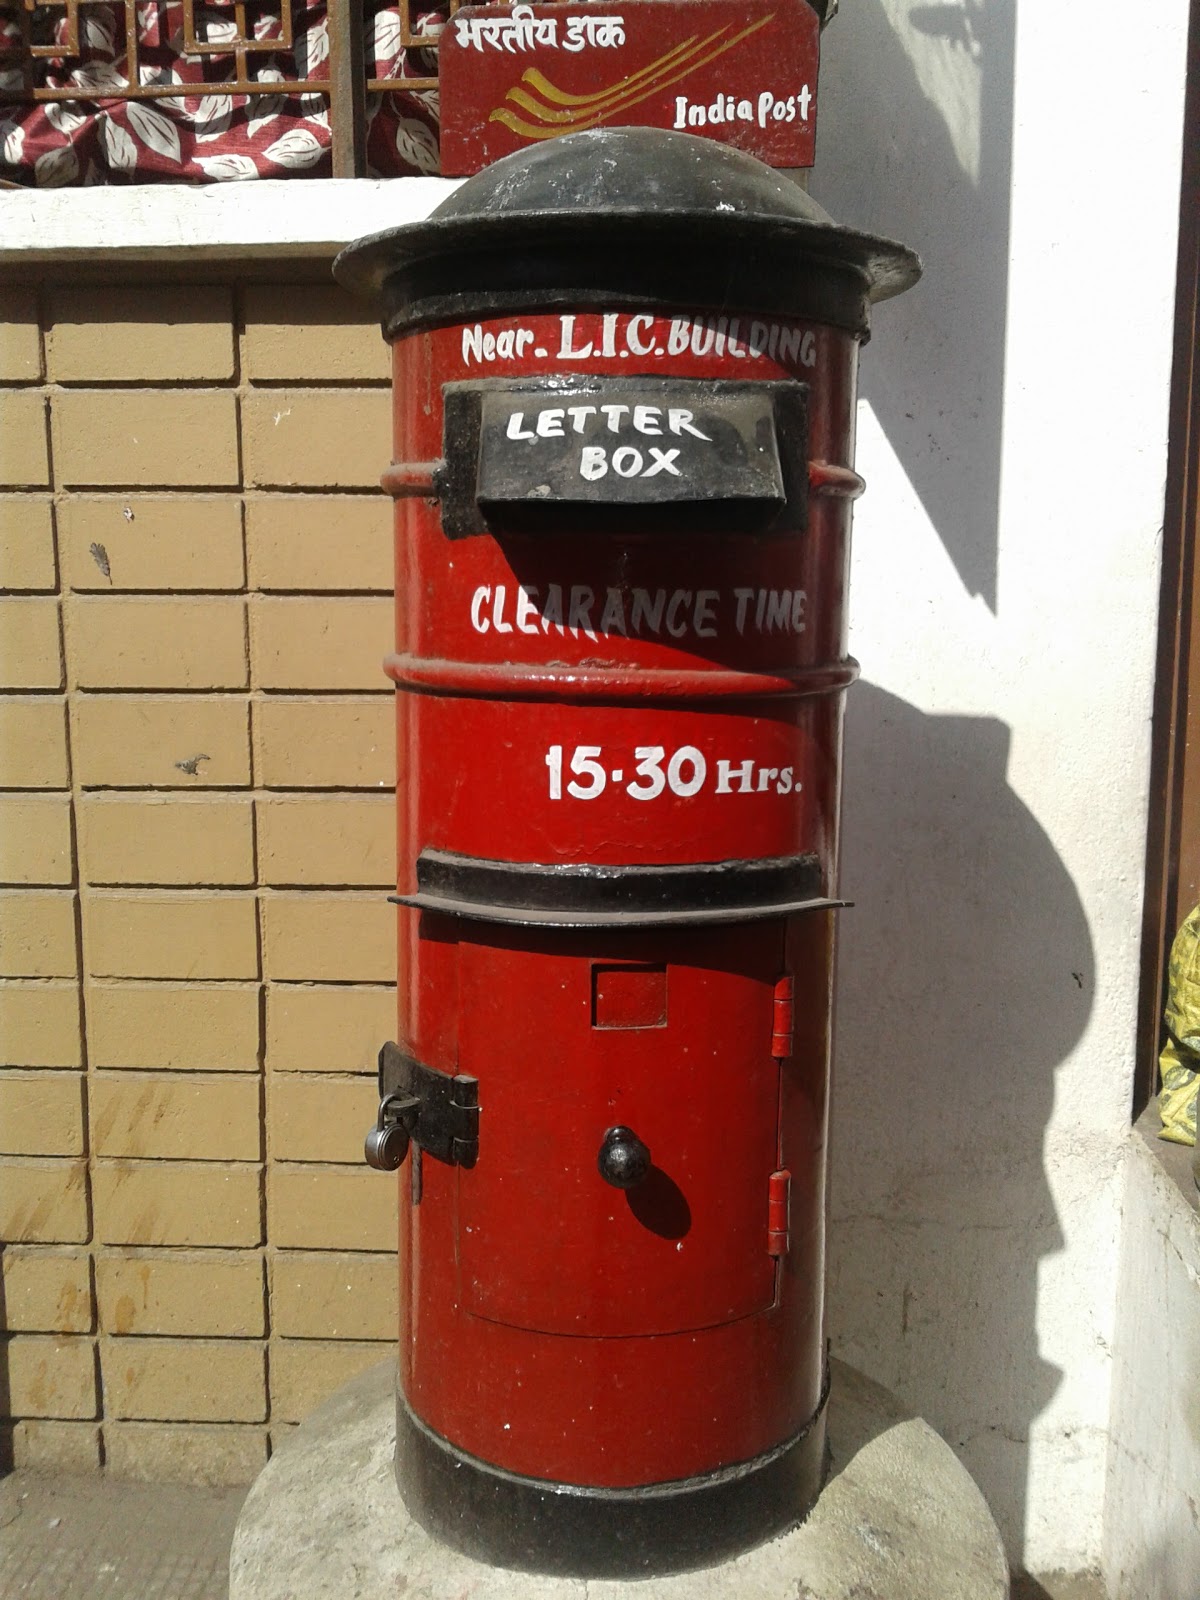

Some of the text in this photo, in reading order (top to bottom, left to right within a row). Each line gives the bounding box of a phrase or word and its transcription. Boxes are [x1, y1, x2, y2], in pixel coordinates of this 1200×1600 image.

[562, 15, 626, 52] डाक
[673, 84, 812, 129] India Post
[667, 314, 817, 368] BUILDING
[506, 405, 713, 442] LETTER
[580, 446, 684, 481] BOX
[471, 583, 807, 643] CLEARANCE TIME
[715, 759, 802, 795] Hrs.
